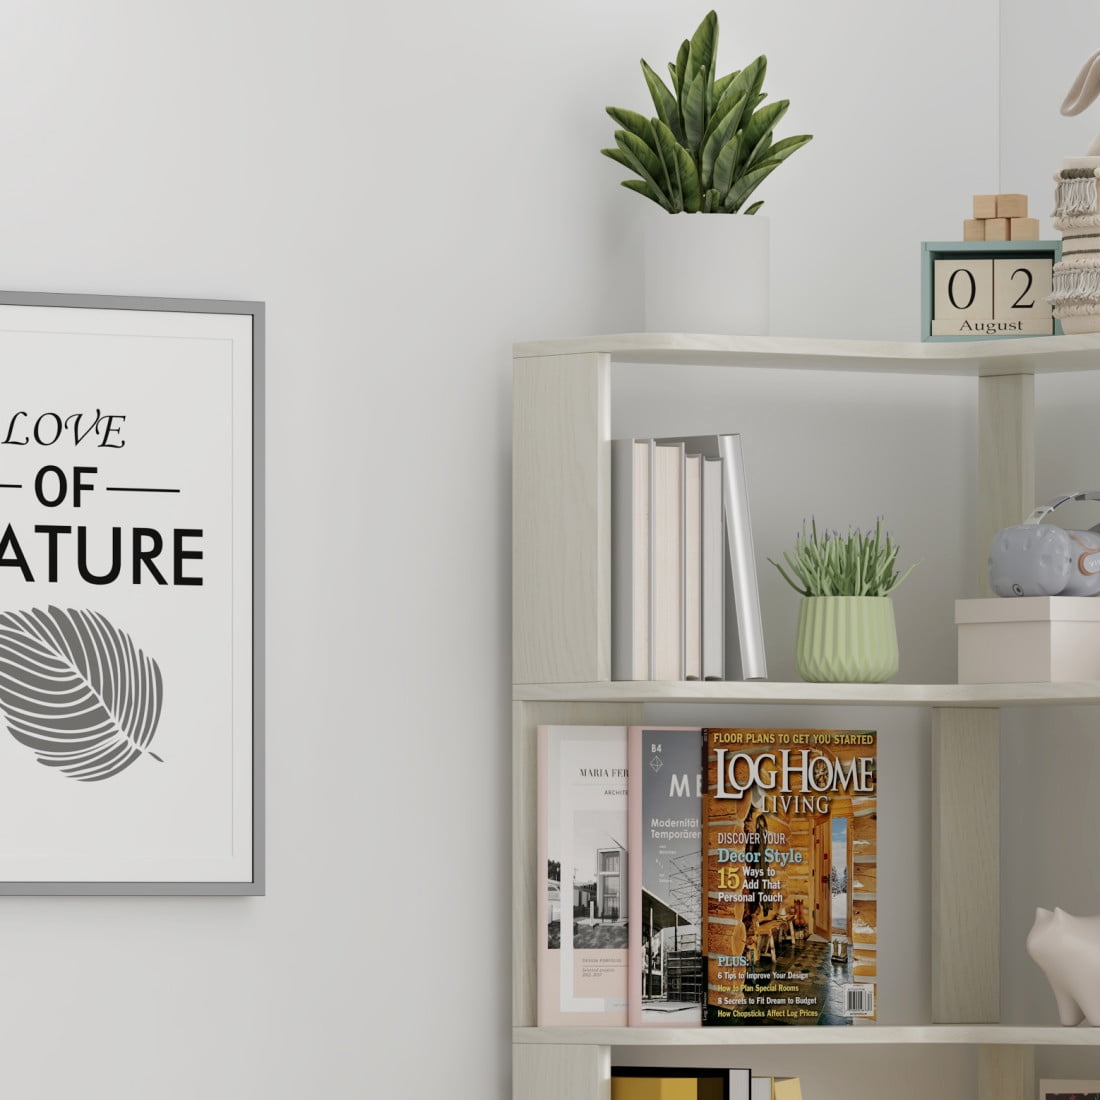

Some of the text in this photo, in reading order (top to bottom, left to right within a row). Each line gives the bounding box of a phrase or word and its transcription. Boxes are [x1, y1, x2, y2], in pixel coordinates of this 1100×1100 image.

[948, 268, 1036, 310] 0 2
[959, 320, 1024, 334] August
[1, 408, 126, 449] LOVE
[34, 465, 98, 508] OF
[0, 522, 204, 586] ATURE
[713, 732, 743, 743] FLOOR
[746, 733, 775, 744] PLANS
[778, 733, 790, 744] TO
[793, 733, 810, 744] GET
[813, 734, 831, 745] YOU
[834, 735, 874, 745] STARTED
[579, 768, 609, 777] MARIA
[761, 795, 830, 814] LIVING
[717, 832, 786, 845] DISCOVER YOUR
[717, 848, 803, 868] Decor Style
[717, 866, 776, 889] 15 Ways to
[742, 879, 781, 890] Add That
[718, 892, 783, 902] Personal Touch
[717, 955, 749, 967] PLUS:
[724, 971, 737, 980] Tips
[746, 971, 771, 980] Improve
[772, 971, 787, 979] Your
[787, 971, 809, 980] Design
[717, 984, 799, 994] How to Plan Special Rooms
[724, 996, 747, 1005] Secrets
[748, 997, 755, 1005] to
[756, 996, 765, 1005] Fit
[766, 996, 786, 1005] Dream
[787, 997, 794, 1005] to
[795, 996, 817, 1006] Budget
[717, 1009, 731, 1018] How
[766, 1009, 785, 1017] Affect
[786, 1009, 798, 1019] Log
[799, 1009, 819, 1017] Prices
